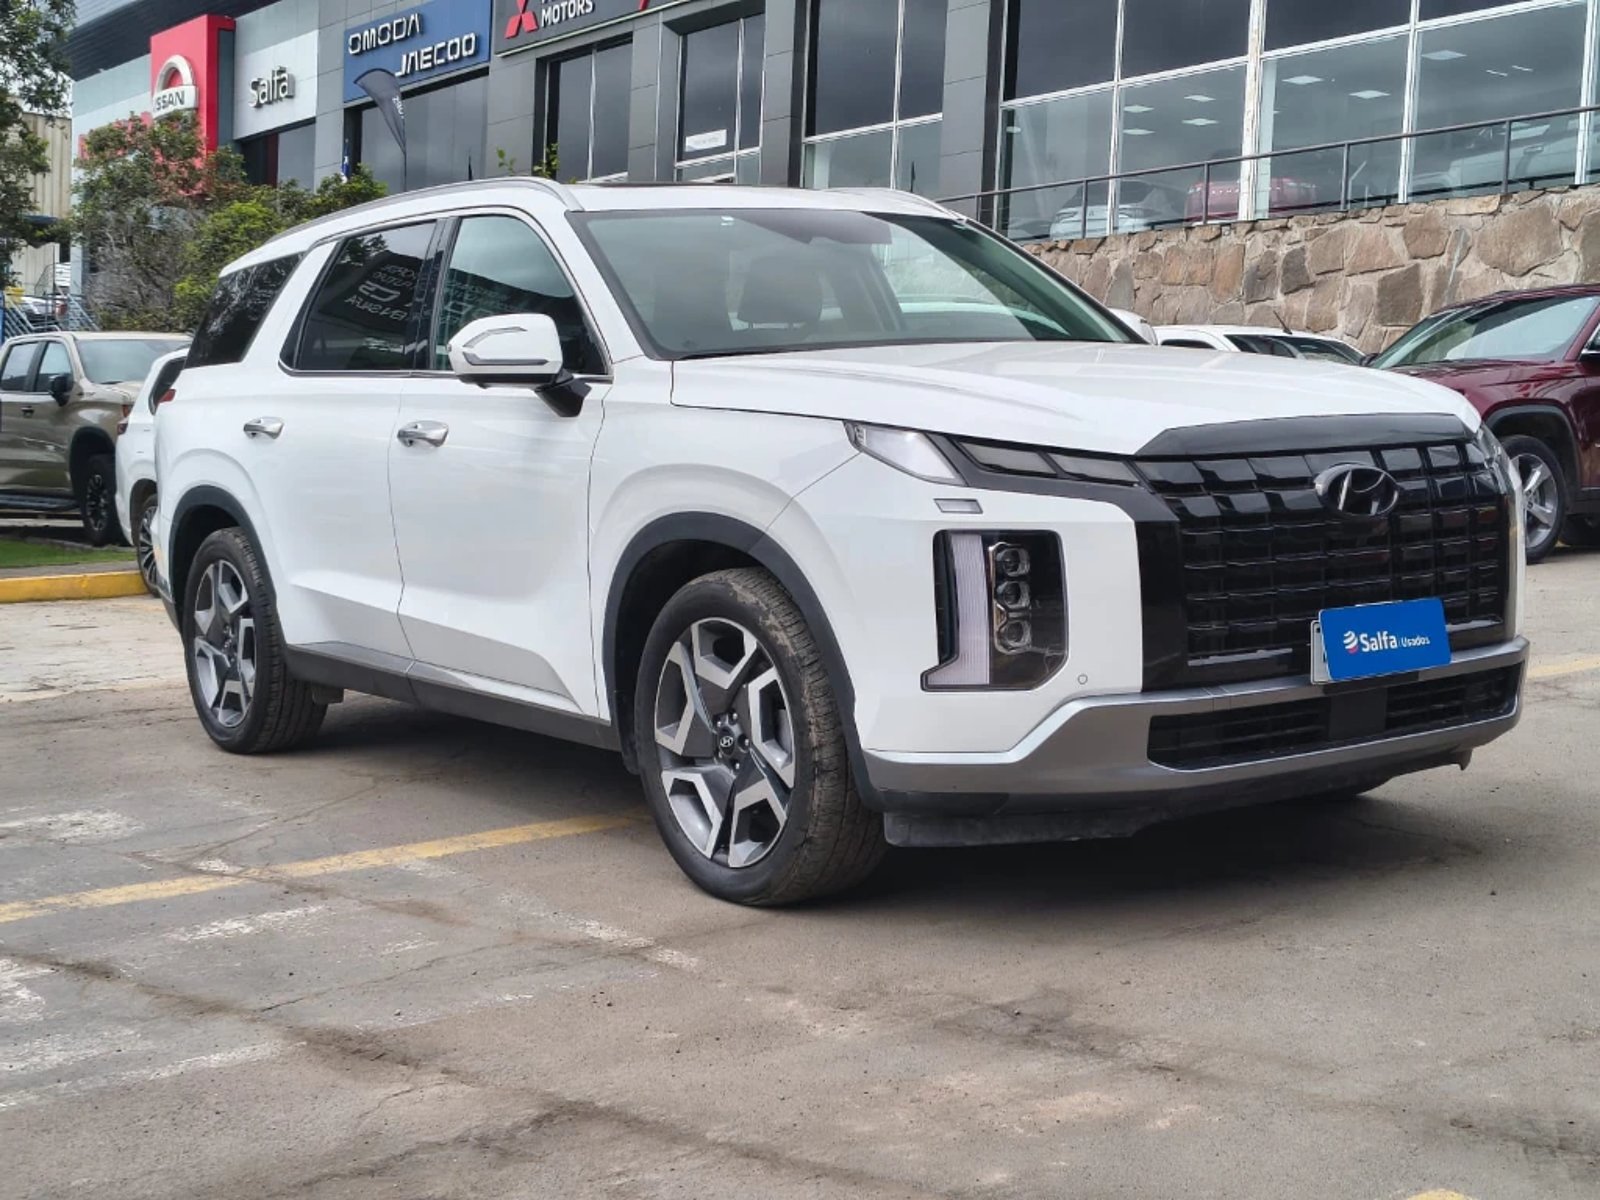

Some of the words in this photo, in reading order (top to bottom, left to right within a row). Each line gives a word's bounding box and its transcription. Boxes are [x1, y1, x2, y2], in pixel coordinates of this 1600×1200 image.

[541, 0, 593, 27] MOTORS
[348, 13, 420, 55] OMODA
[395, 32, 476, 77] JAECOO
[154, 90, 185, 111] SSAN
[248, 66, 293, 107] Salfa
[1359, 631, 1398, 653] Salfa
[1401, 635, 1430, 648] Usados
